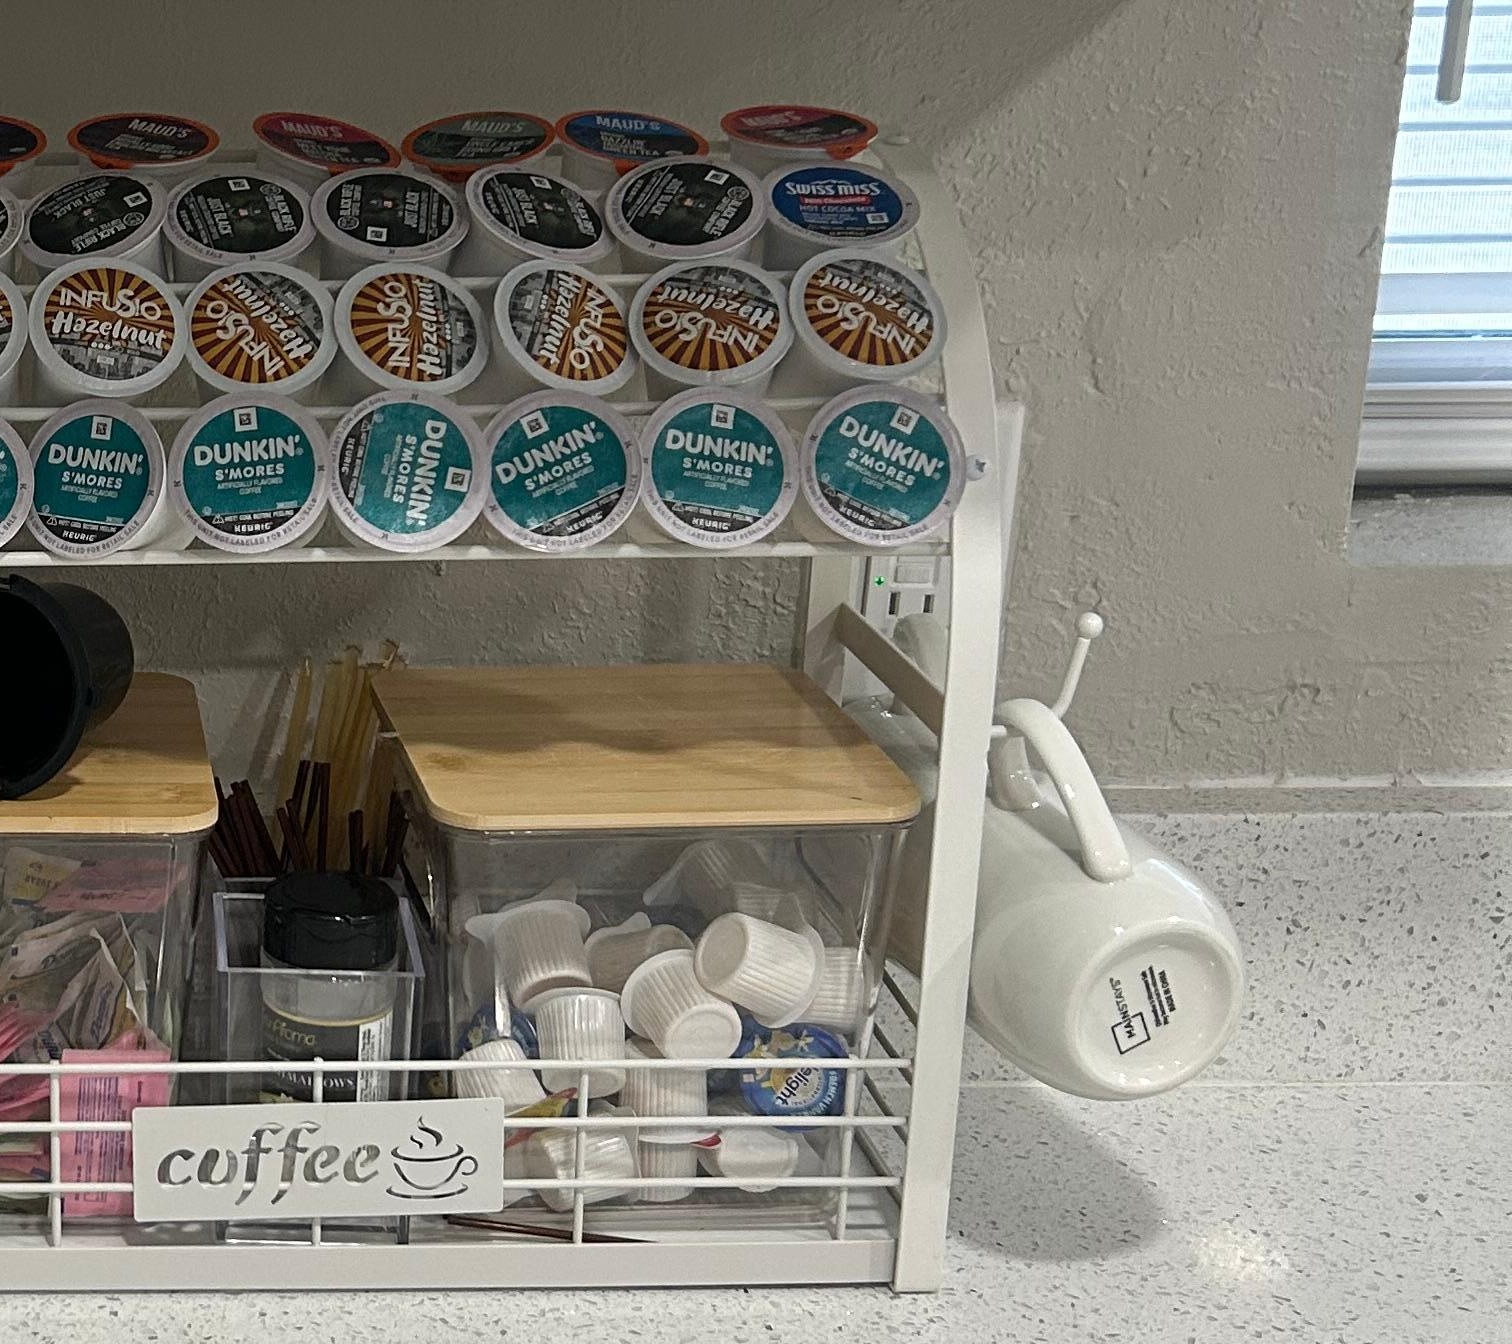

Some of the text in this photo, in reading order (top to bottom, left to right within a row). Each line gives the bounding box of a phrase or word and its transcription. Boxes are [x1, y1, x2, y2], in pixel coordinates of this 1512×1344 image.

[128, 118, 192, 139] MAUD'S
[280, 119, 344, 138] MAUD'S
[461, 119, 525, 134] MAUD'S
[595, 115, 662, 131] MAUD'S
[785, 181, 881, 196] SWISS MISS
[59, 287, 162, 321] INFUSIO
[223, 279, 314, 360] Hazelnut
[539, 273, 583, 366] Hazelnut
[657, 284, 776, 330] Hazelnut
[819, 270, 932, 334] Hazelnut
[51, 310, 167, 350] Hazelnut
[205, 299, 286, 377] INFUSIO
[377, 280, 414, 369] INFUSIO
[412, 278, 443, 377] Hazelnut
[569, 287, 609, 370] INFUSIO
[654, 308, 761, 354] INFUSIO
[816, 295, 918, 356] INFUSIO
[47, 443, 144, 475] DUNKIN'
[193, 434, 301, 466] DUNKIN'
[341, 437, 356, 474] KEURIG
[495, 421, 597, 485] DUNKIN'
[665, 428, 773, 466] DUNKIN'
[838, 415, 945, 477] DUNKIN'
[61, 470, 123, 490] S'MORES
[215, 463, 285, 482] S'MORES
[392, 433, 418, 504] S'MORES
[405, 419, 448, 527] DUNKIN'
[524, 452, 593, 491] S'MORES
[682, 457, 754, 479] S'MORES
[847, 447, 916, 487] S'MORES
[62, 530, 98, 542] KEURIG
[234, 522, 274, 533] KEURIG
[566, 510, 604, 533] KEURIG
[691, 517, 731, 531] KEURIG
[55, 541, 86, 555] LABELED
[87, 544, 101, 554] FOR
[101, 533, 125, 550] RETAIL
[1109, 979, 1136, 1039] MAINSTAYS
[775, 1067, 820, 1106] elight
[157, 1120, 382, 1207] coffee
